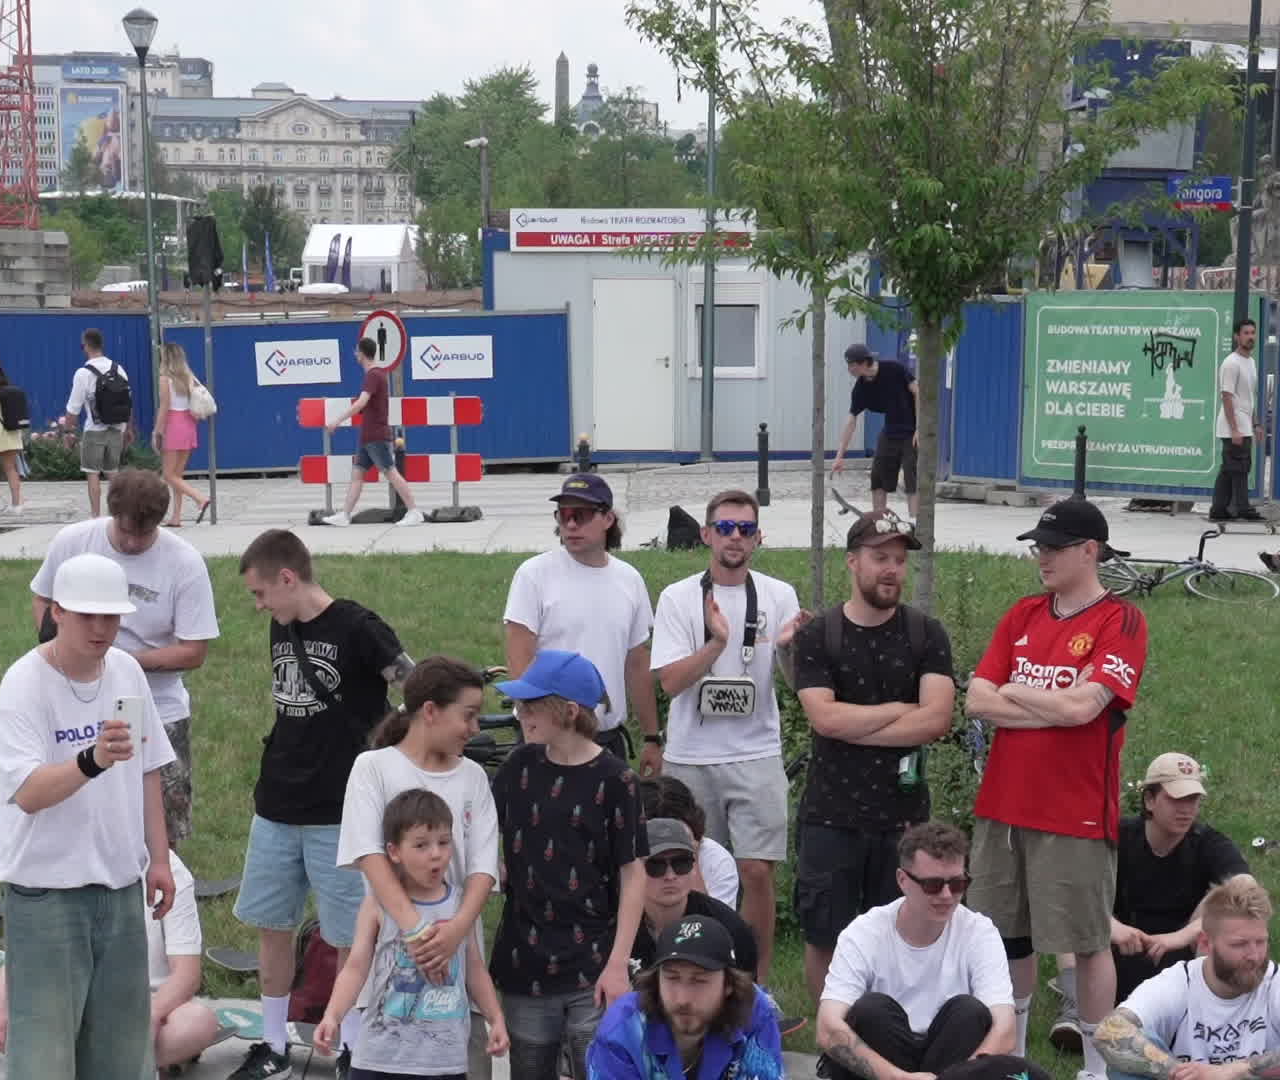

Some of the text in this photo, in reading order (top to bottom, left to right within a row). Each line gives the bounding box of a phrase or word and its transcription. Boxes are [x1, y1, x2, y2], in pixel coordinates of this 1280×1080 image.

[551, 233, 590, 245] UWAGA
[601, 233, 630, 245] Strefa
[1047, 324, 1202, 337] BUDOWA TEATRU TR WARSZAWA
[276, 357, 332, 367] WARBUD
[430, 353, 485, 362] WARBUD
[1046, 359, 1131, 375] ZMIENIAMY
[1045, 380, 1133, 400] WARSZAWĘ
[1044, 401, 1126, 418] DLA CIEBIE
[1129, 443, 1203, 457] UTRUDNIENIA
[55, 724, 96, 744] POLO
[1193, 1016, 1267, 1043] SKATE
